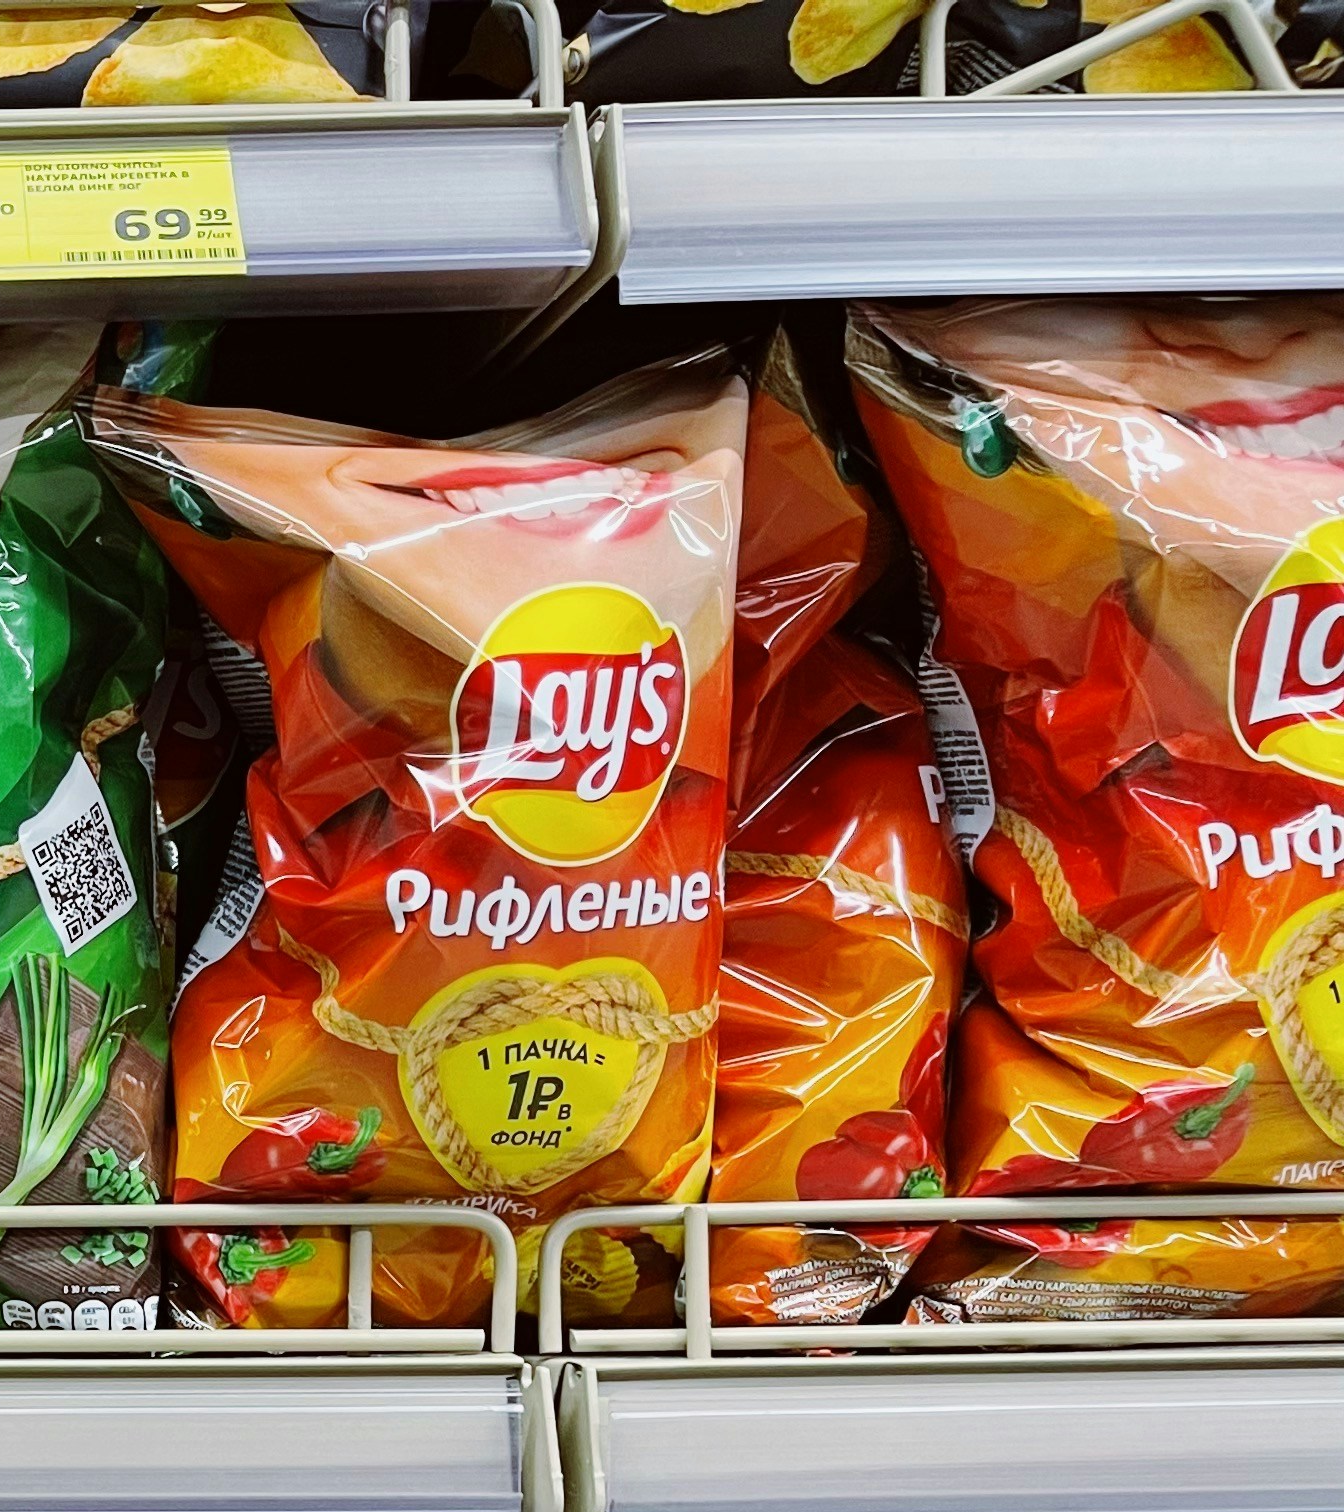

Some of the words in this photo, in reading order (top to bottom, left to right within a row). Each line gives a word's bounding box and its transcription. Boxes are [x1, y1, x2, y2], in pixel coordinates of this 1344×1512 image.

[25, 171, 107, 182] НАТУРАЛЬН
[111, 171, 179, 181] КРЕВЕТКА
[26, 183, 75, 193] БЕЛОМ
[78, 183, 115, 192] ВИНЕ
[113, 208, 192, 241] 69
[199, 208, 228, 222] 99
[474, 640, 676, 802] Lay's
[384, 868, 712, 950] Рифленые
[503, 1038, 591, 1066] ПАЧКА
